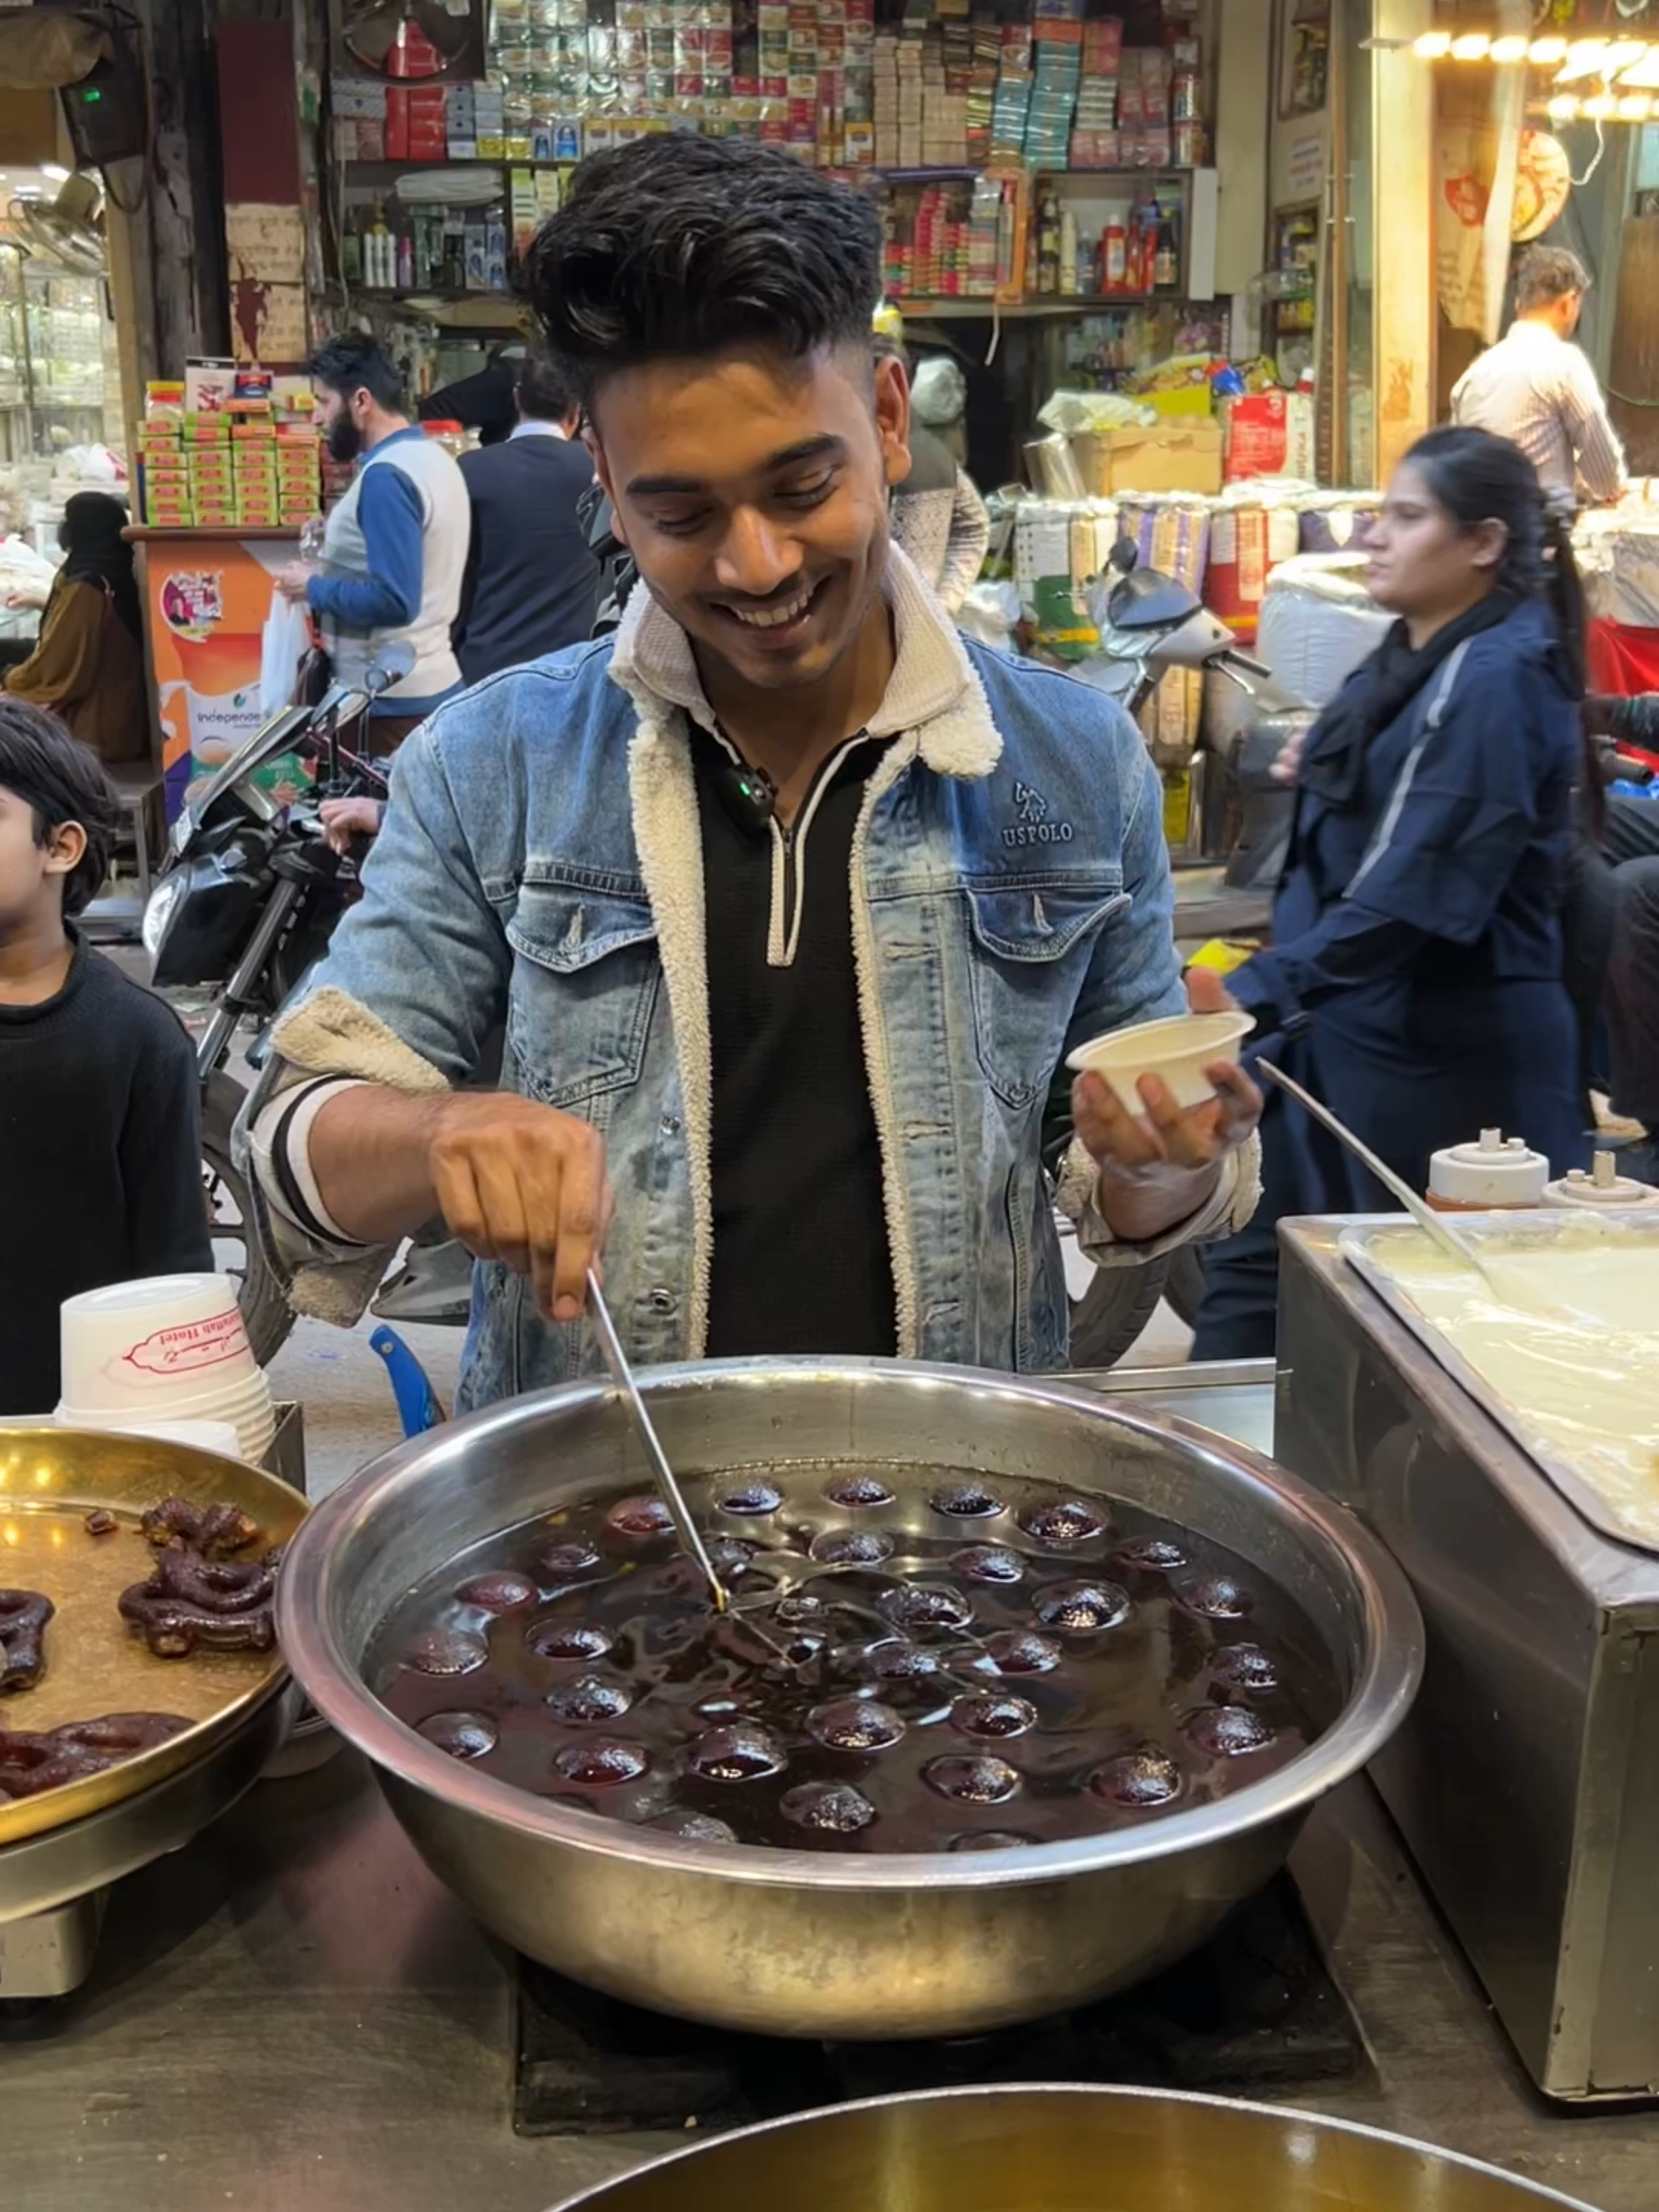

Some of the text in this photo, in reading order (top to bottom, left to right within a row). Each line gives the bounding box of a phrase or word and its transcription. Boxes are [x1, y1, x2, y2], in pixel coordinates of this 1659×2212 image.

[197, 707, 261, 724] Independe
[1002, 823, 1072, 846] USPOLO
[160, 1328, 199, 1346] Hotel
